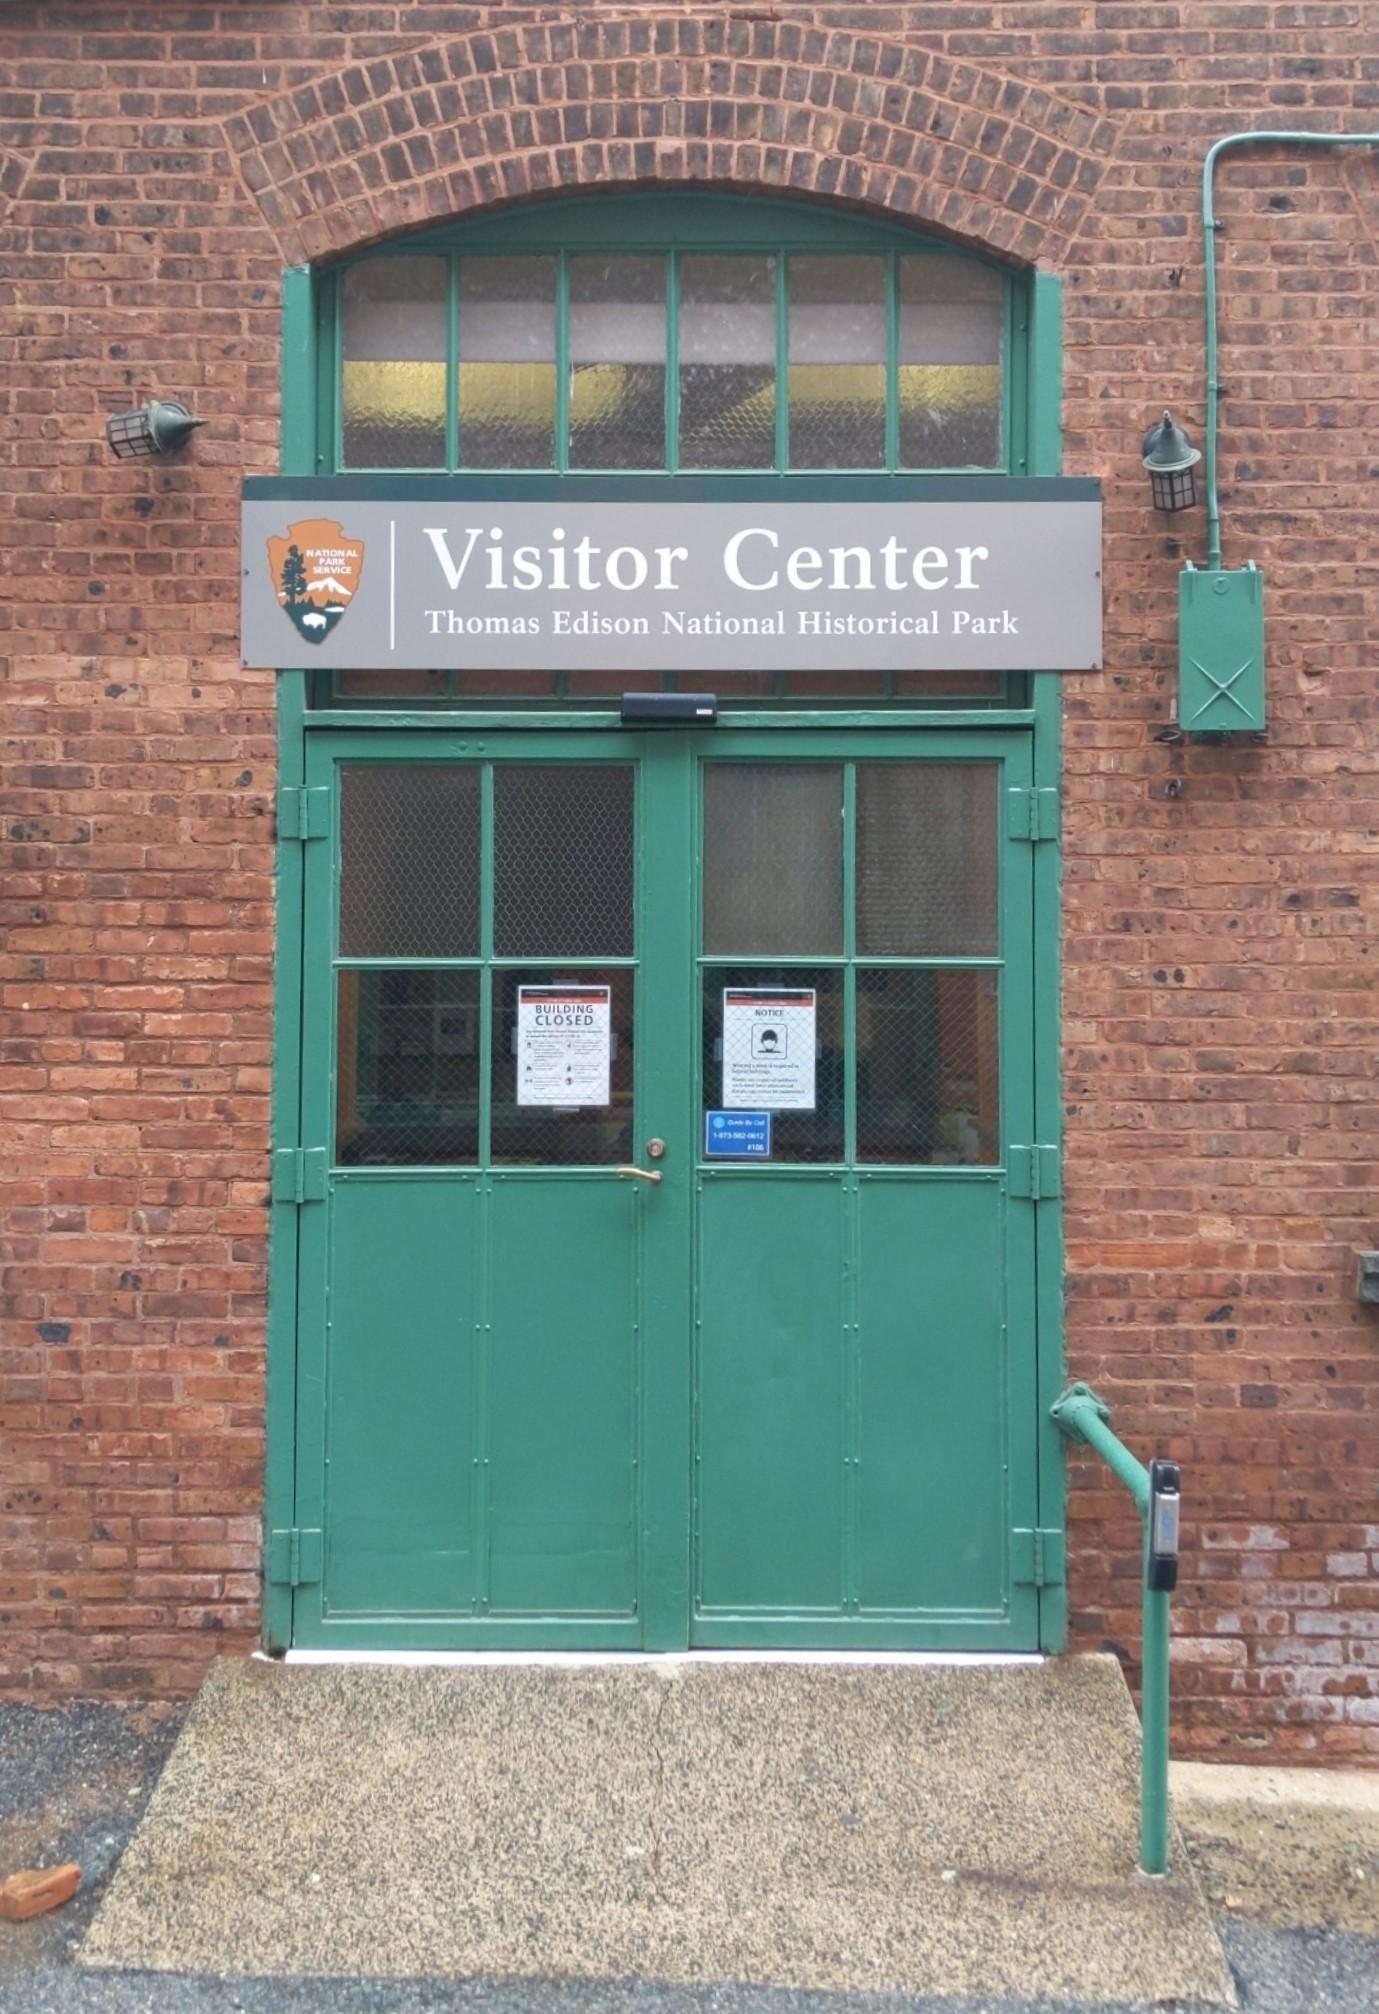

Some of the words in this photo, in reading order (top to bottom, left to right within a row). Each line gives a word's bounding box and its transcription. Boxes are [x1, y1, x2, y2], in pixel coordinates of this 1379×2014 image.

[306, 549, 359, 558] NATIONAL
[319, 558, 346, 566] PARK
[423, 526, 689, 591] Visitor
[722, 527, 989, 592] Center
[312, 566, 353, 574] SERVICE
[424, 609, 540, 635] Thomas
[551, 609, 650, 636] Edison
[661, 609, 786, 636] National
[797, 609, 940, 636] Historical
[951, 609, 1019, 635] Park
[535, 1004, 594, 1014] BUILDING
[755, 1009, 785, 1017] NOTICE
[535, 1014, 594, 1026] CLOSED
